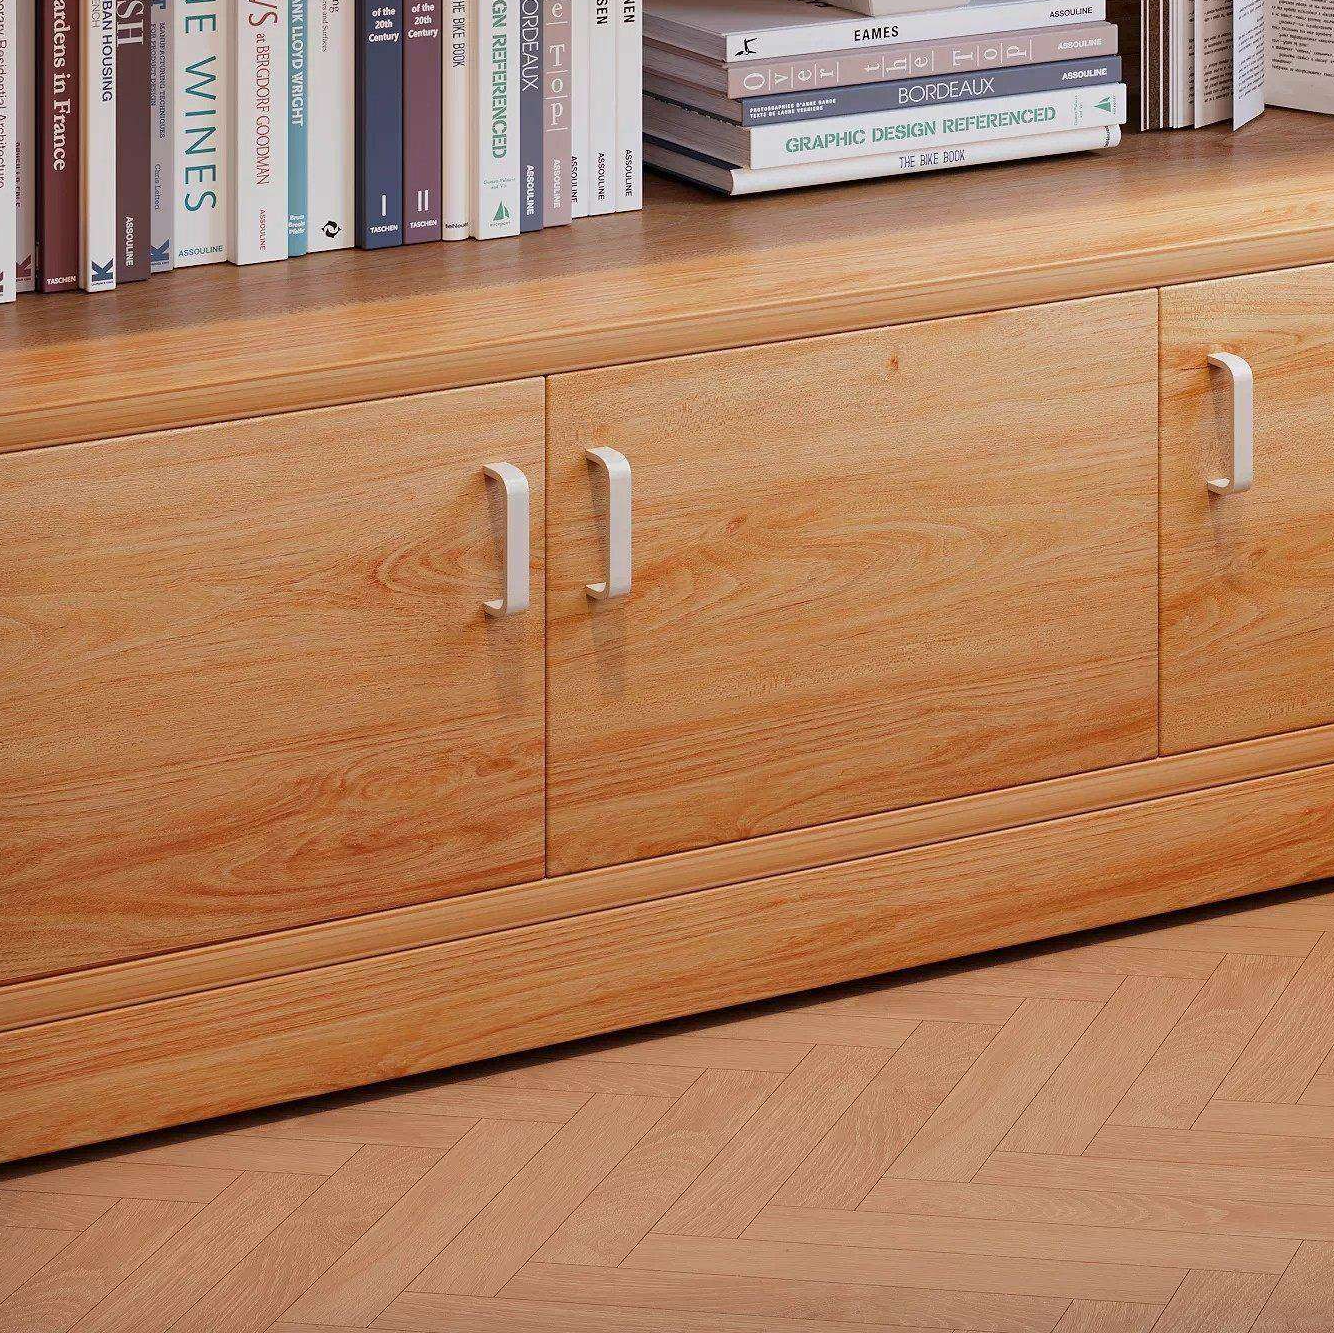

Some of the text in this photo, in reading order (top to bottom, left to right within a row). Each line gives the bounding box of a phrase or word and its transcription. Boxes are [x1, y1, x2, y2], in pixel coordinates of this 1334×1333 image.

[854, 25, 899, 42] EAMES
[53, 74, 71, 94] in
[898, 77, 995, 104] BORDEAUX
[52, 99, 71, 171] France
[785, 106, 1056, 154] GRAPHIC DESIGN REFERENCED
[899, 148, 966, 168] THE BIKE BOOK
